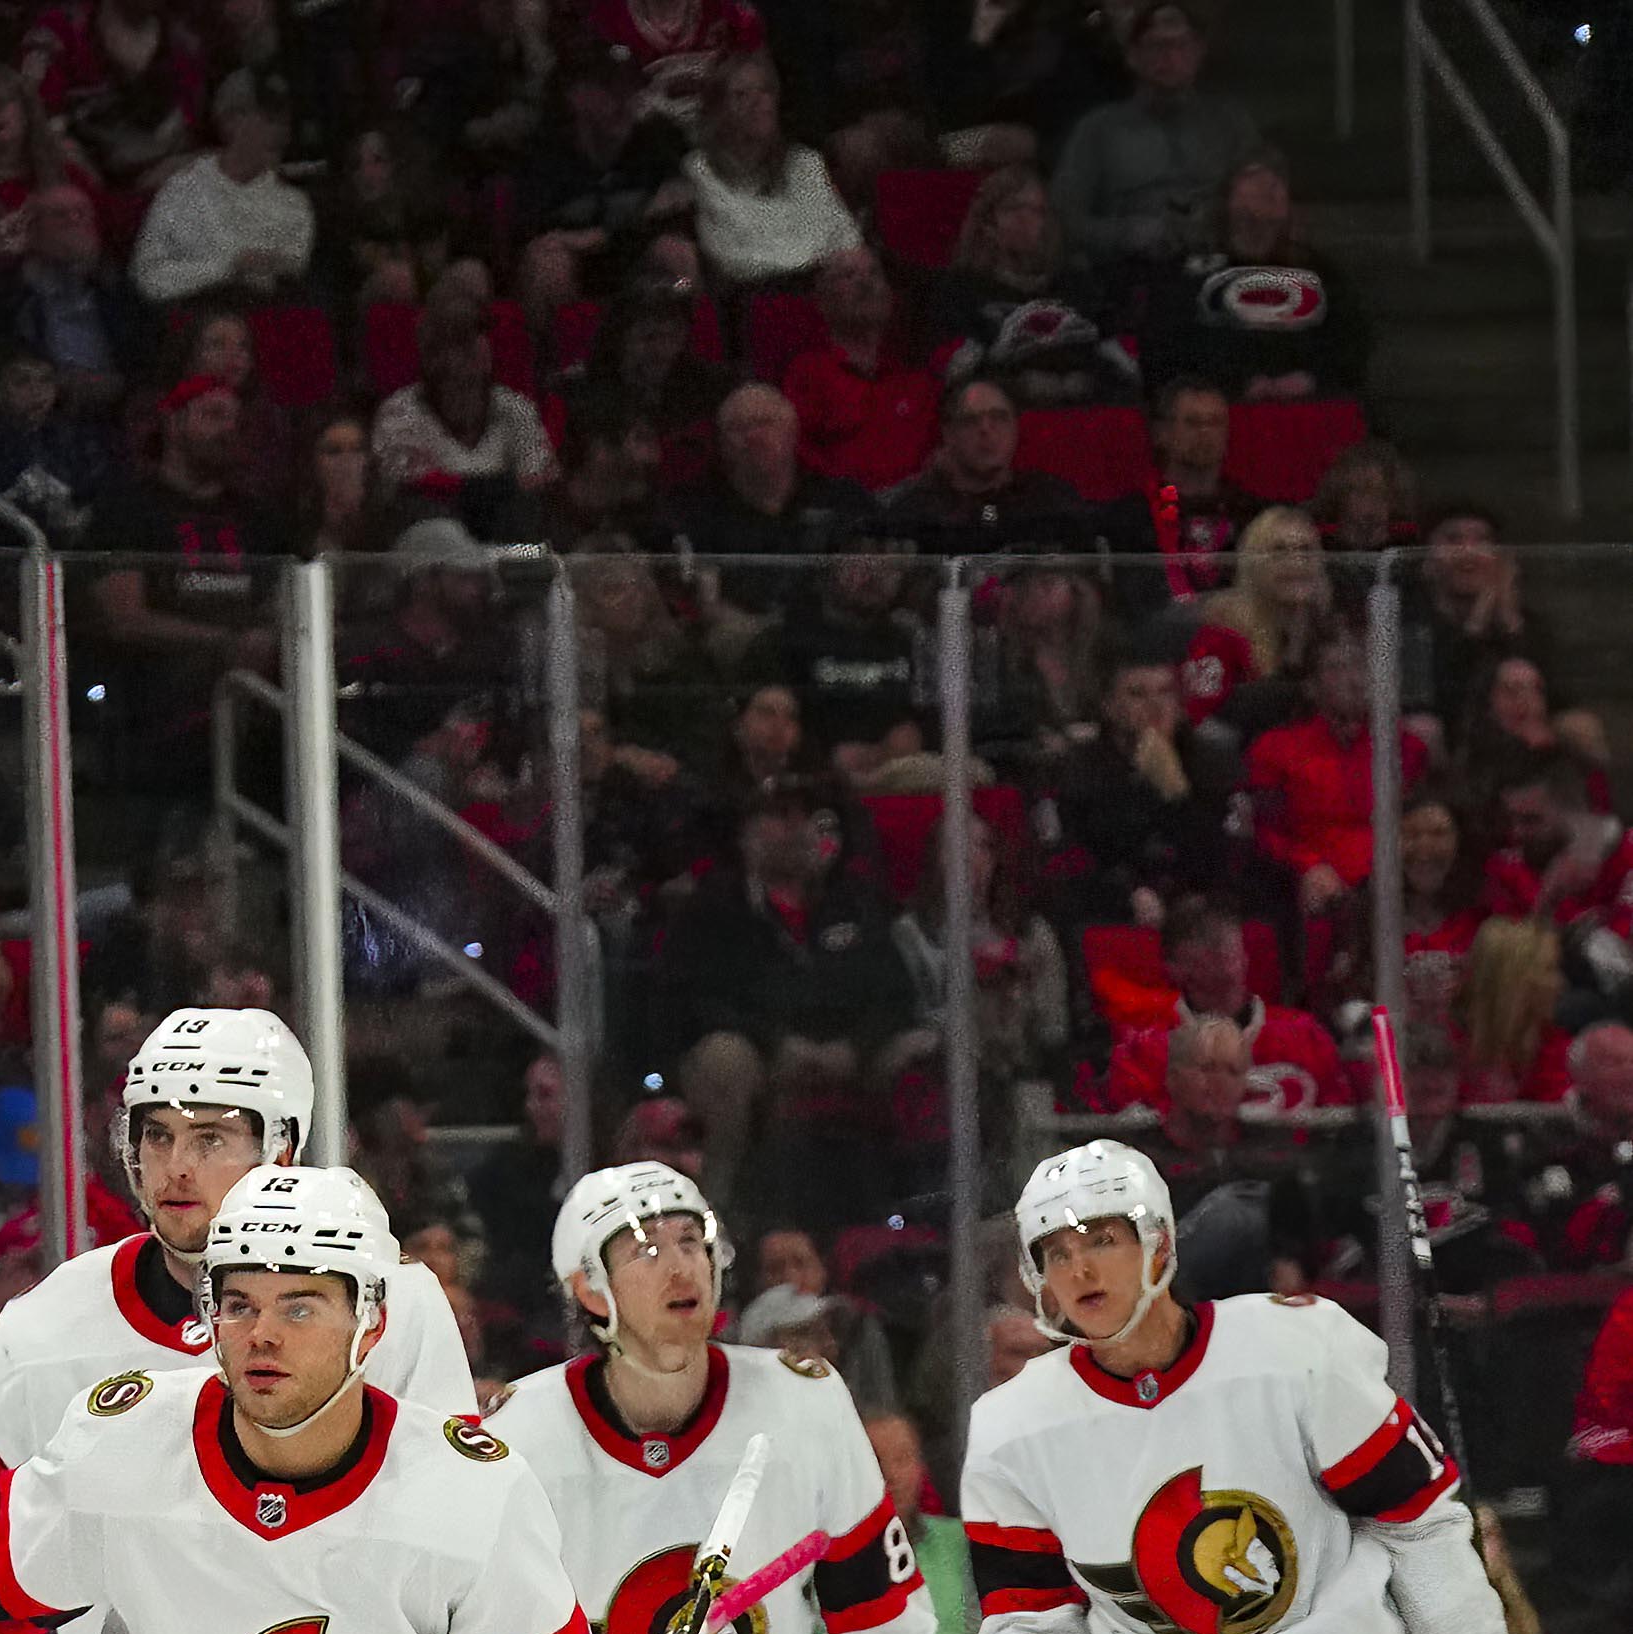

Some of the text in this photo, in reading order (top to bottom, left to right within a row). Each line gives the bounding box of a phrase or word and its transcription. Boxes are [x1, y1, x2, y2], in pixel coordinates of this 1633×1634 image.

[172, 1019, 210, 1034] 13
[151, 1061, 206, 1073] CCM
[260, 1177, 300, 1194] 12
[240, 1221, 303, 1234] CCM
